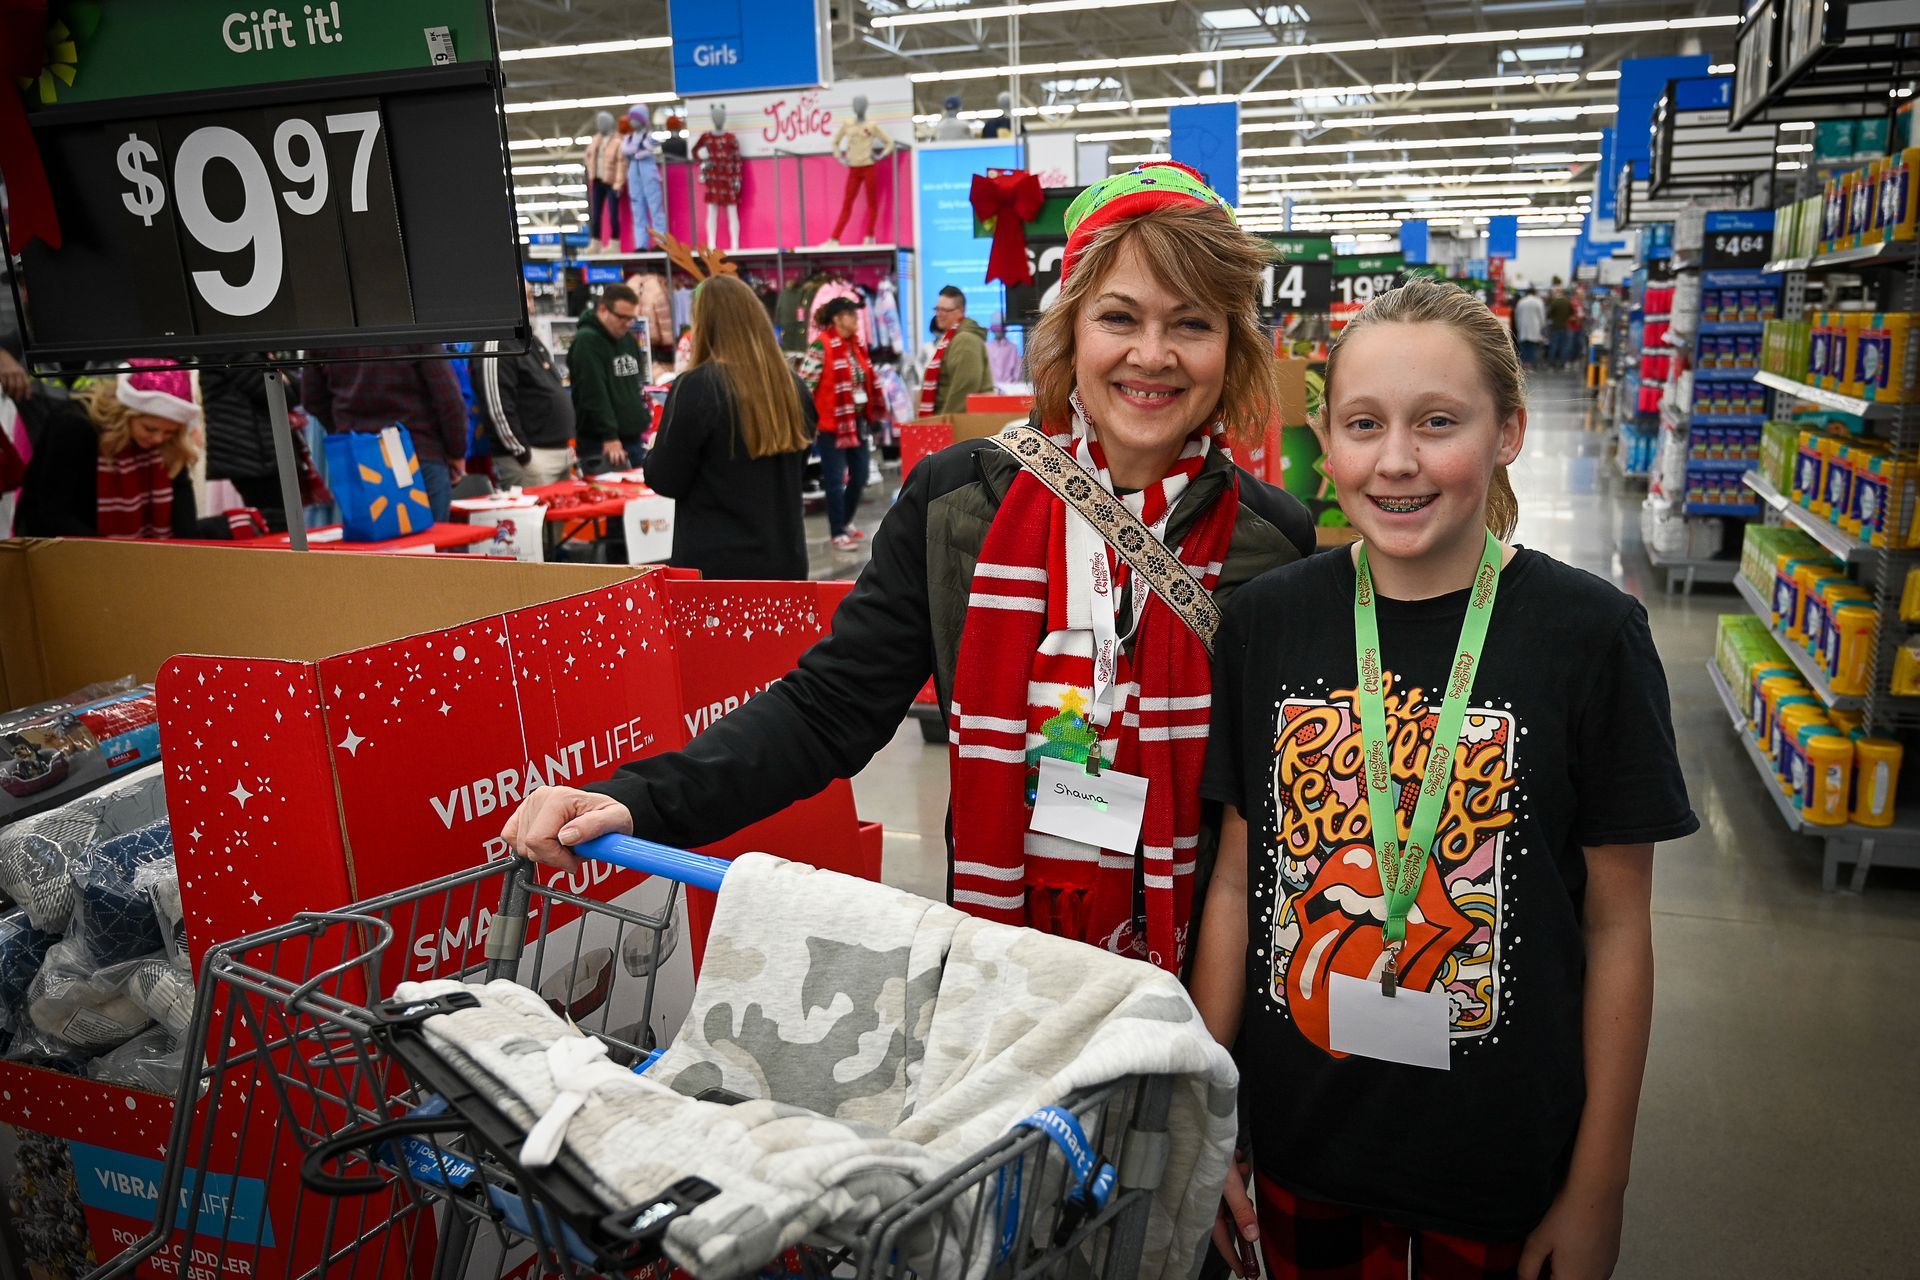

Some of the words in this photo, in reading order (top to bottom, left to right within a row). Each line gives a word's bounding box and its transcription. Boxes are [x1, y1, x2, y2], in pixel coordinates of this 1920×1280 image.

[222, 9, 296, 53] Gift
[303, 1, 343, 45] it!
[693, 43, 737, 67] Girls
[763, 101, 832, 143] Justice
[430, 741, 585, 829] VIBRANT
[1054, 782, 1109, 805] Shauna
[1032, 1110, 1086, 1168] almart
[150, 1255, 180, 1276] PET
